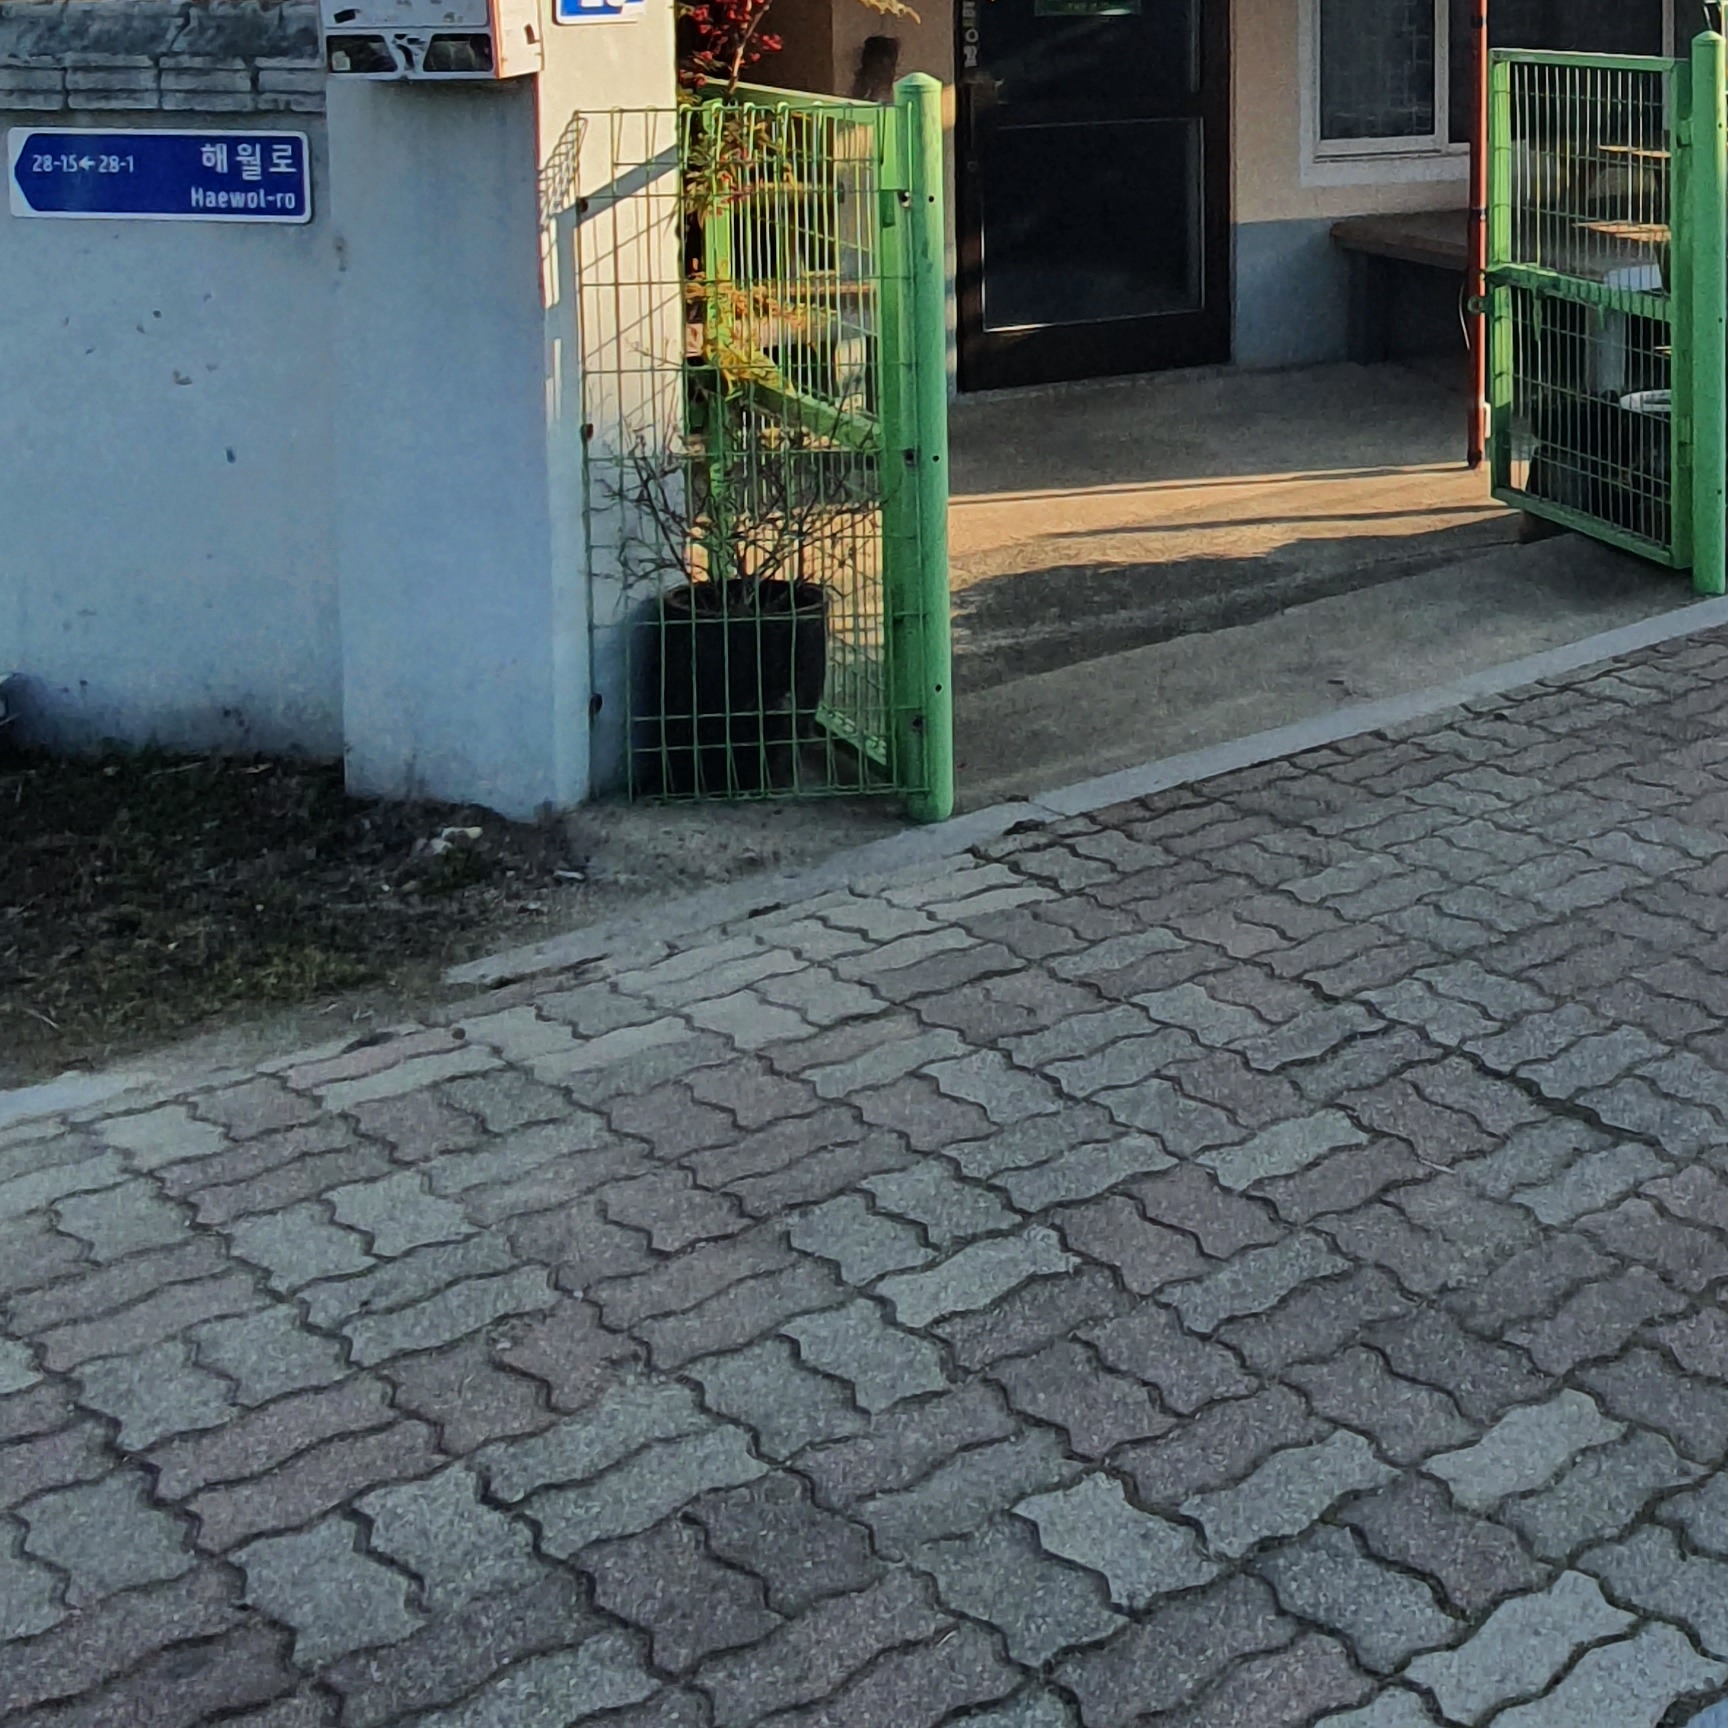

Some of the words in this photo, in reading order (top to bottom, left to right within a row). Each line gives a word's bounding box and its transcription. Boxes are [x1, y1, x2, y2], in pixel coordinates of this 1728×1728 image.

[32, 153, 77, 172] 28-15
[100, 154, 134, 173] 28-1
[201, 142, 297, 181] 해월로
[190, 186, 296, 210] Haewol-ro
